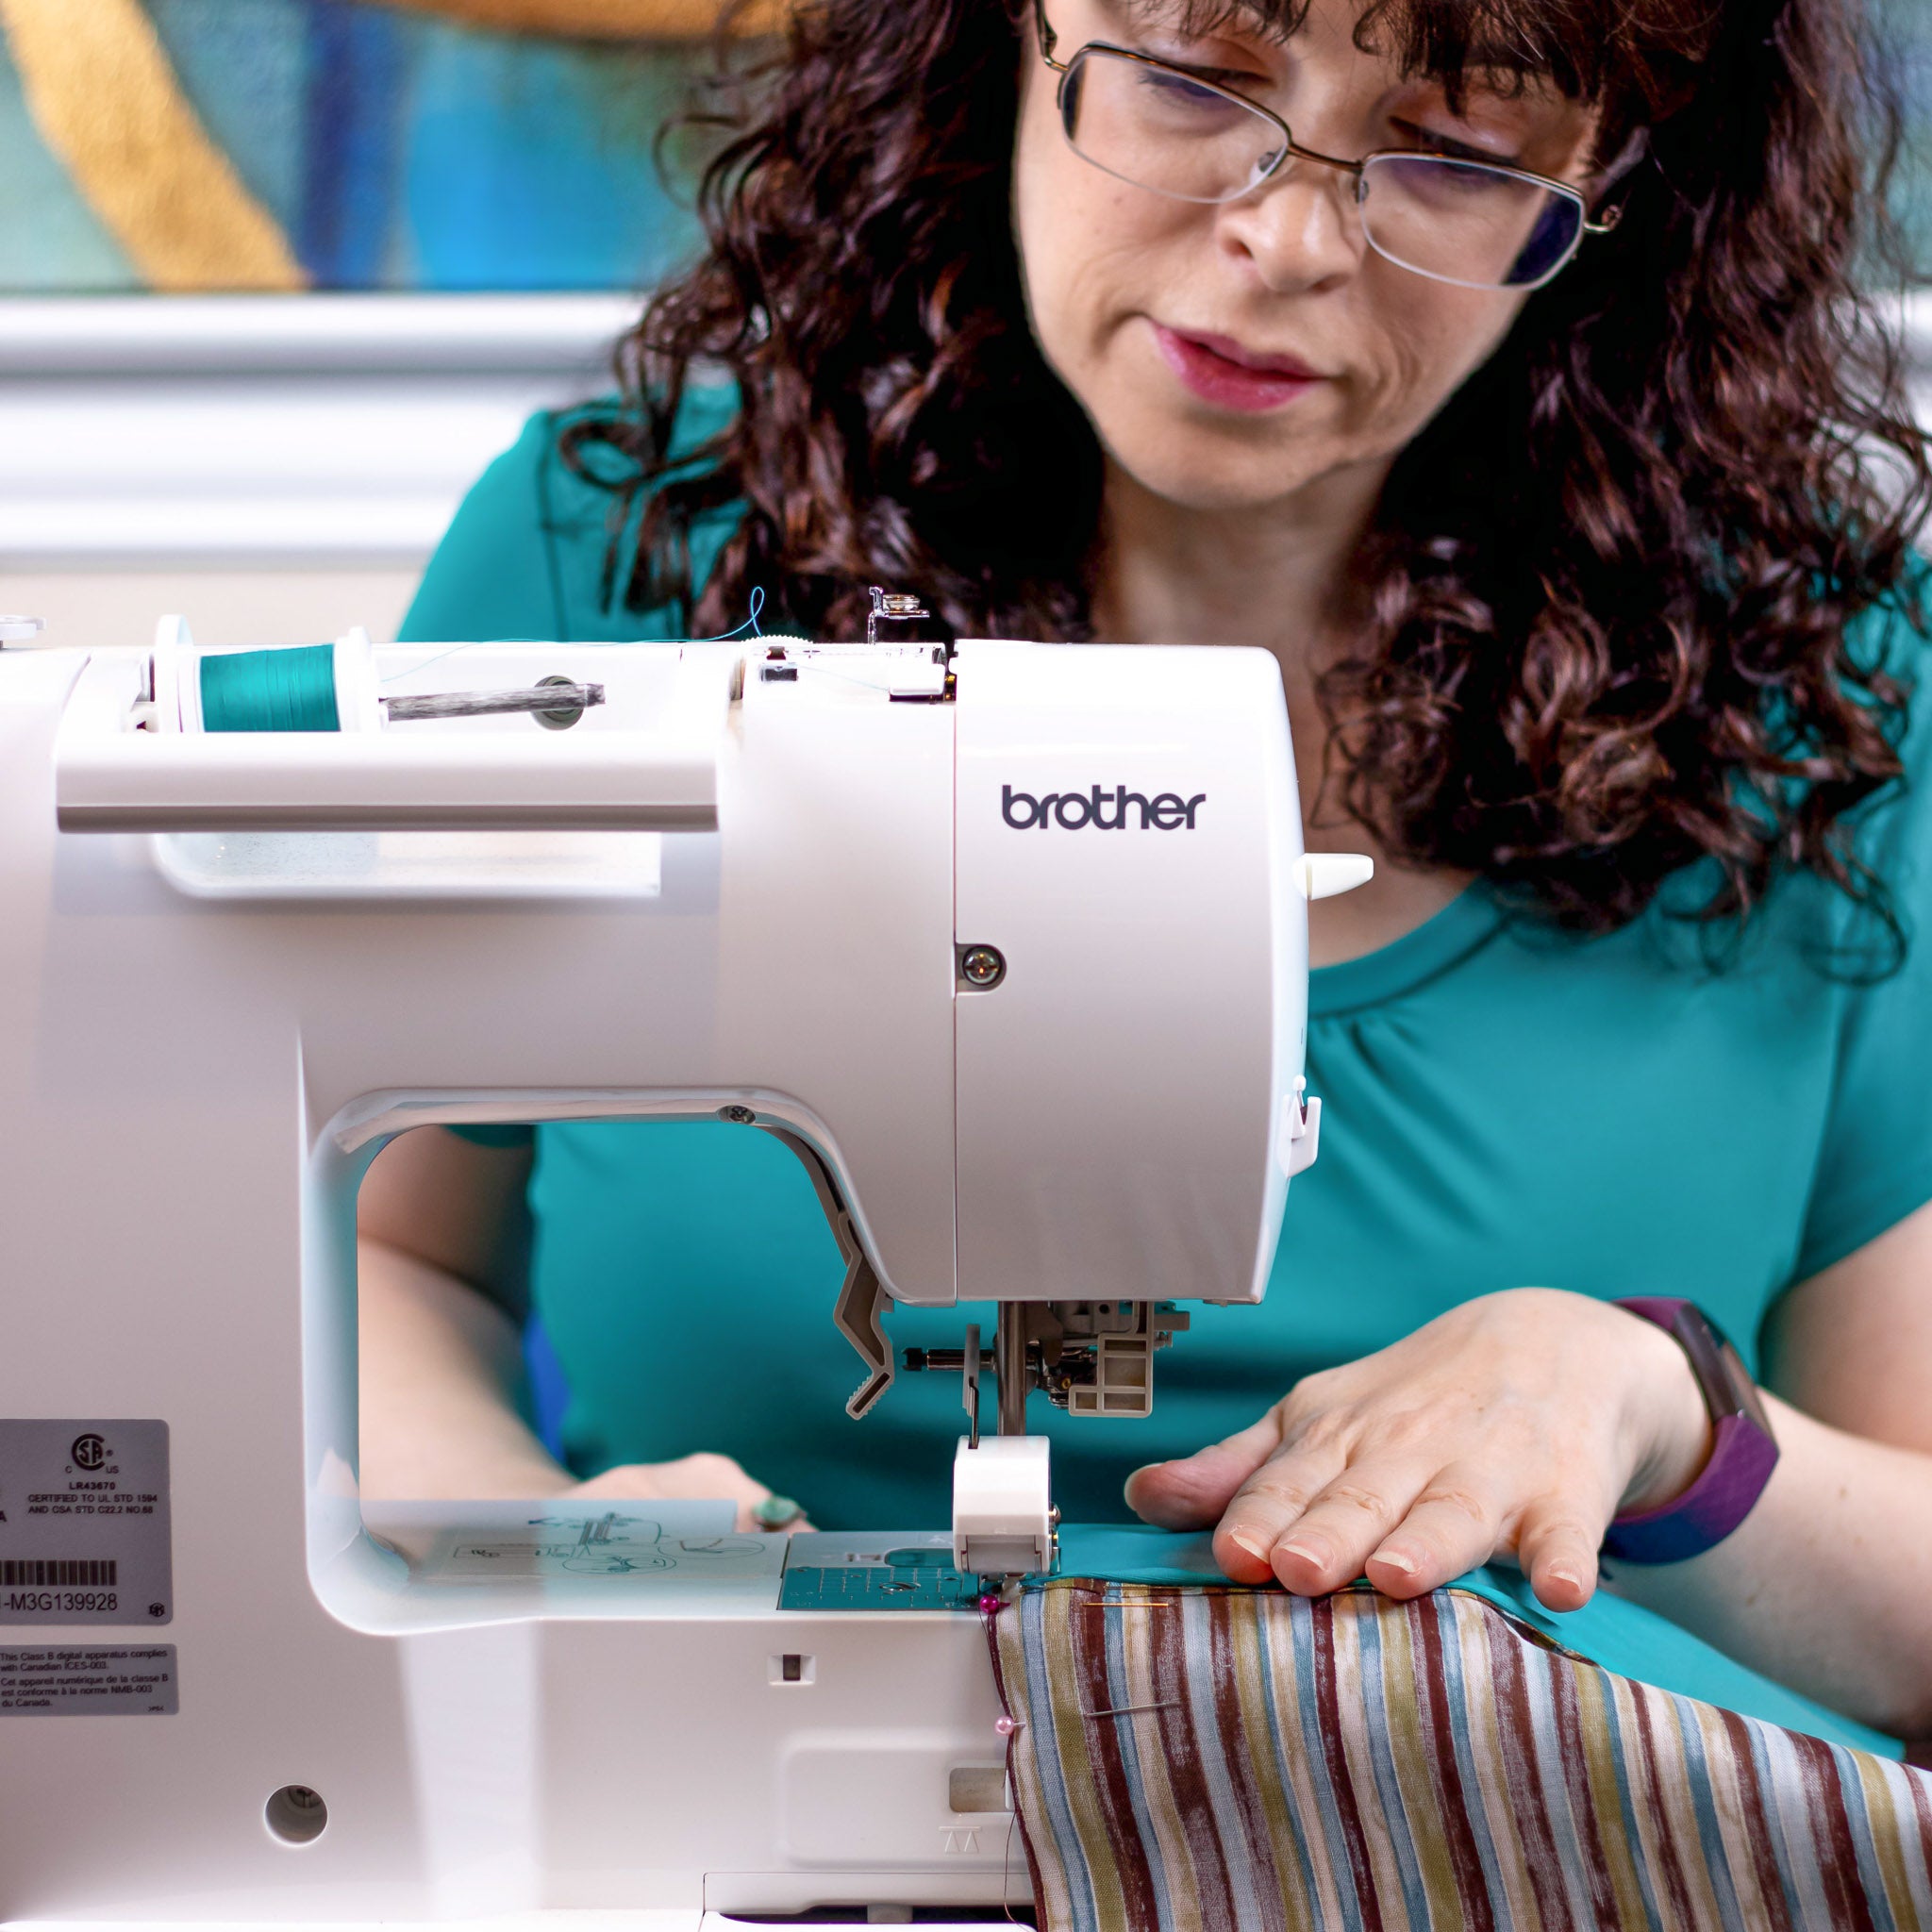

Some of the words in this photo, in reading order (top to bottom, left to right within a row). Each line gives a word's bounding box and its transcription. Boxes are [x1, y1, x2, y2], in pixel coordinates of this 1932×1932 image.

[1002, 784, 1207, 830] brother
[28, 1494, 78, 1503] CERTIFIED
[82, 1494, 94, 1503] TO
[28, 1506, 49, 1514] AND
[52, 1506, 72, 1514] CSA
[75, 1506, 94, 1514] STD
[97, 1506, 123, 1514] C22.2
[0, 1653, 18, 1661] This
[20, 1652, 45, 1661] Class
[47, 1652, 54, 1660] B
[57, 1651, 82, 1662] digital
[85, 1651, 128, 1661] apparatus
[130, 1649, 168, 1660] complies
[0, 1663, 18, 1672] with
[20, 1662, 62, 1672] Canadian
[0, 1677, 16, 1686] Cet
[19, 1677, 55, 1688] appareil
[57, 1675, 104, 1686] numérique
[106, 1674, 118, 1684] de
[120, 1674, 128, 1683] la
[130, 1674, 160, 1683] classe
[161, 1674, 169, 1682] B
[1, 1689, 14, 1697] est
[17, 1688, 58, 1697] conforme
[69, 1687, 77, 1695] la
[79, 1687, 108, 1695] norme
[110, 1684, 153, 1694] NMB-003
[2, 1699, 13, 1707] du
[15, 1698, 53, 1707] Canada.
